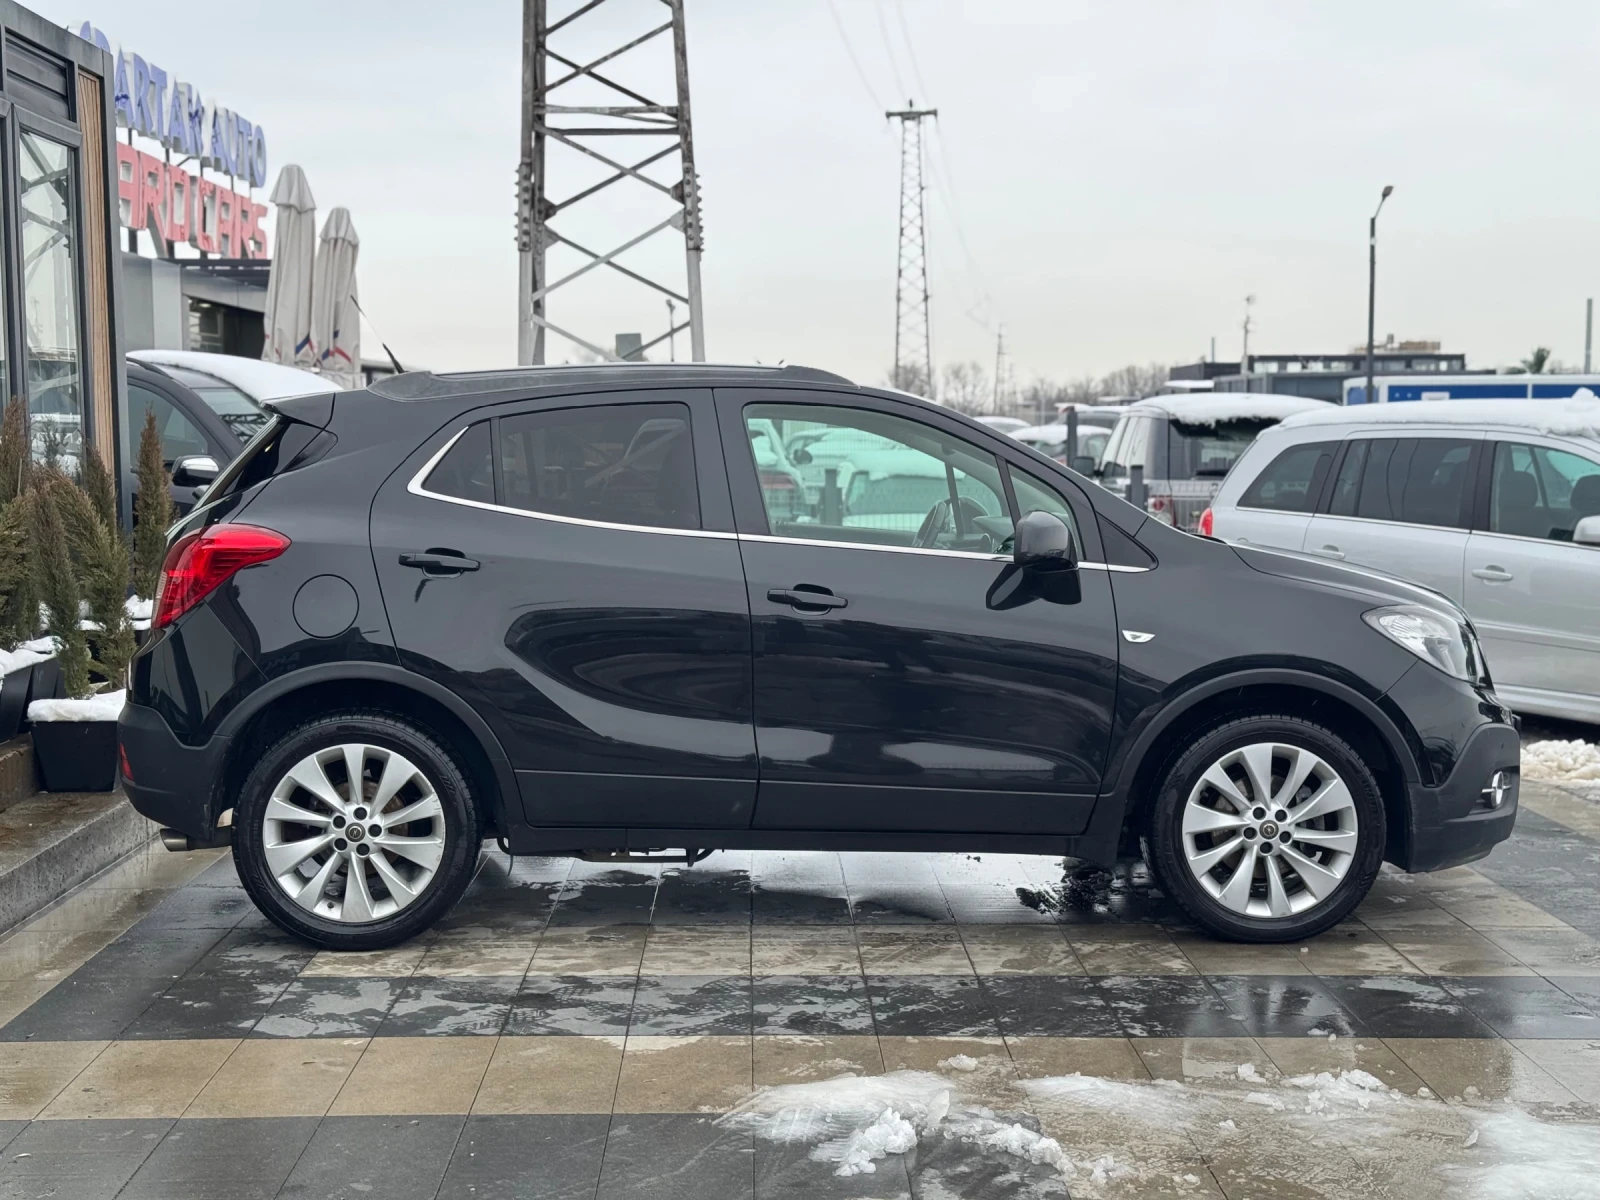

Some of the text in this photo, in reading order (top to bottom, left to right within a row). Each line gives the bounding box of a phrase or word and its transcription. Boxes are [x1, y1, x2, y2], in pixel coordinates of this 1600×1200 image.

[80, 20, 267, 188] ARTAK AUTO
[194, 175, 268, 260] CARS
